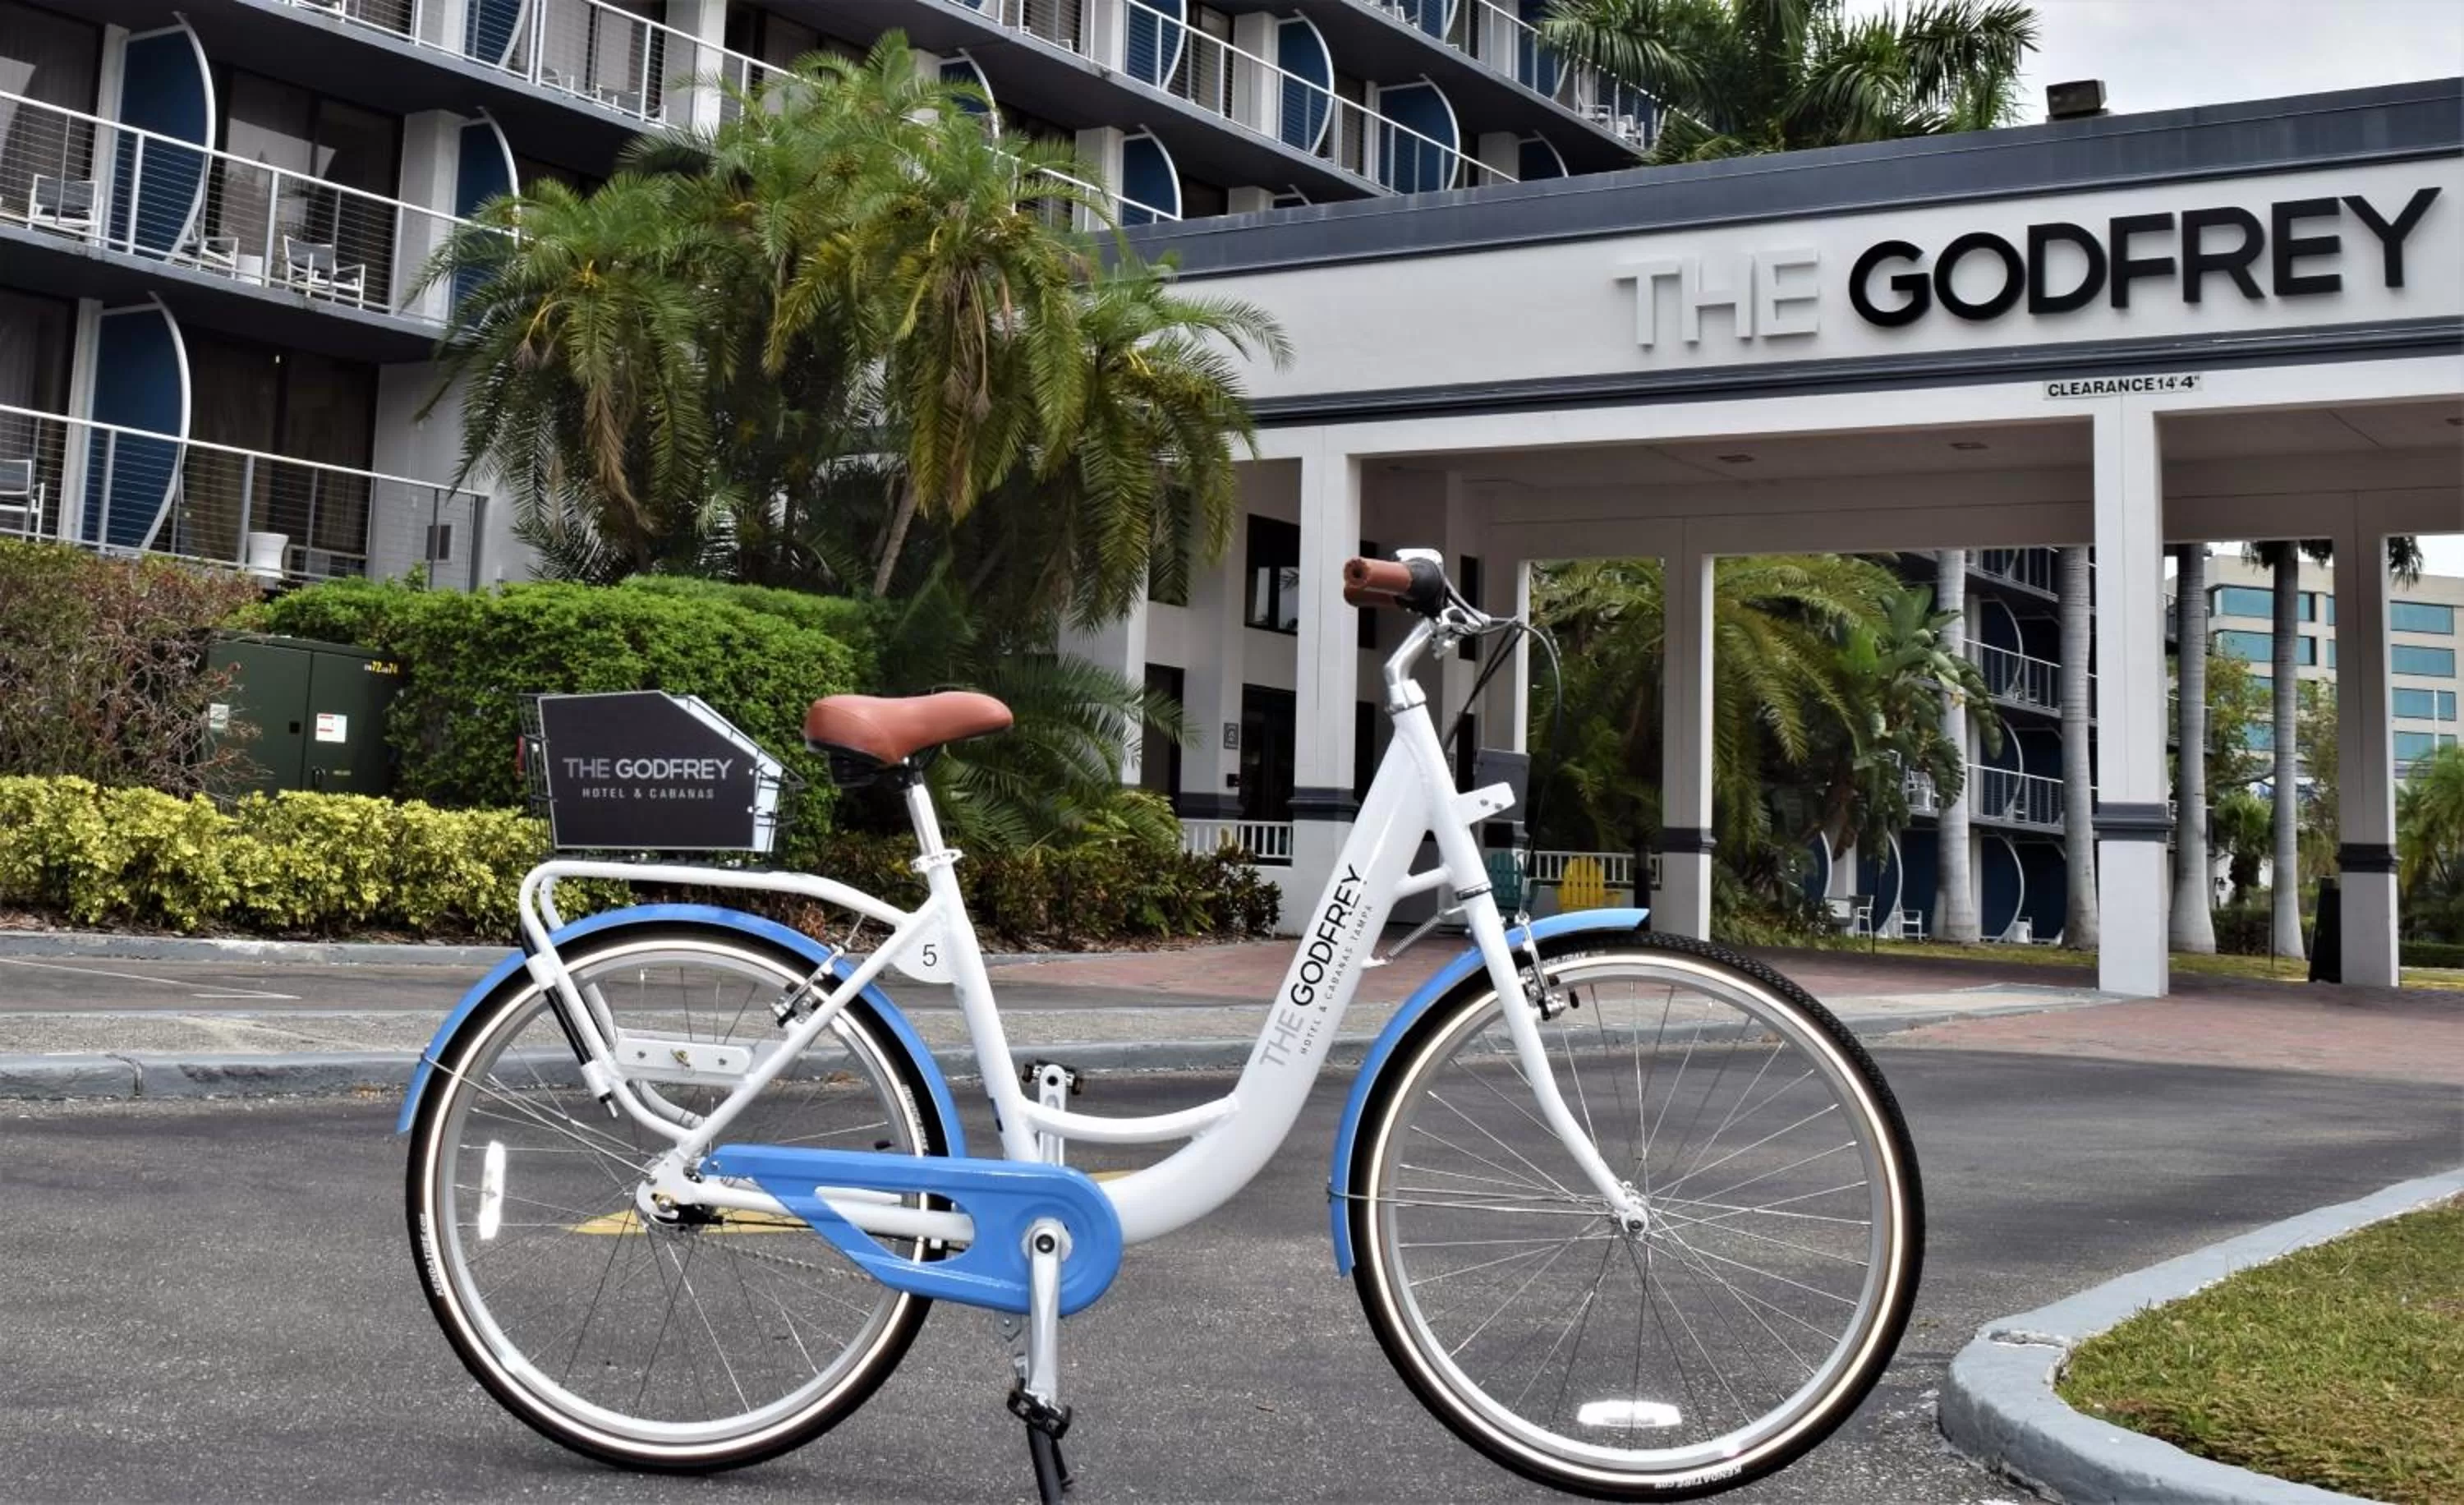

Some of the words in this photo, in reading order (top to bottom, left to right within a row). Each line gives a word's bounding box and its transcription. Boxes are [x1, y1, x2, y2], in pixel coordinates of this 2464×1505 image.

[1615, 247, 1819, 348] THE
[1848, 186, 2442, 328] GODFREY
[2048, 377, 2154, 397] CLEARANCE
[563, 757, 611, 779] THE
[615, 757, 733, 780] GODFREY
[582, 788, 625, 799] HOTEL
[633, 788, 642, 799] &
[650, 788, 715, 799] CABANAS
[922, 944, 938, 967] 5
[1258, 1008, 1305, 1066] THE
[1290, 863, 1368, 1007] GODFREY
[1300, 1018, 1322, 1056] HOTEL
[1324, 946, 1354, 1001] CABANAS
[1351, 904, 1373, 941] TAMPA
